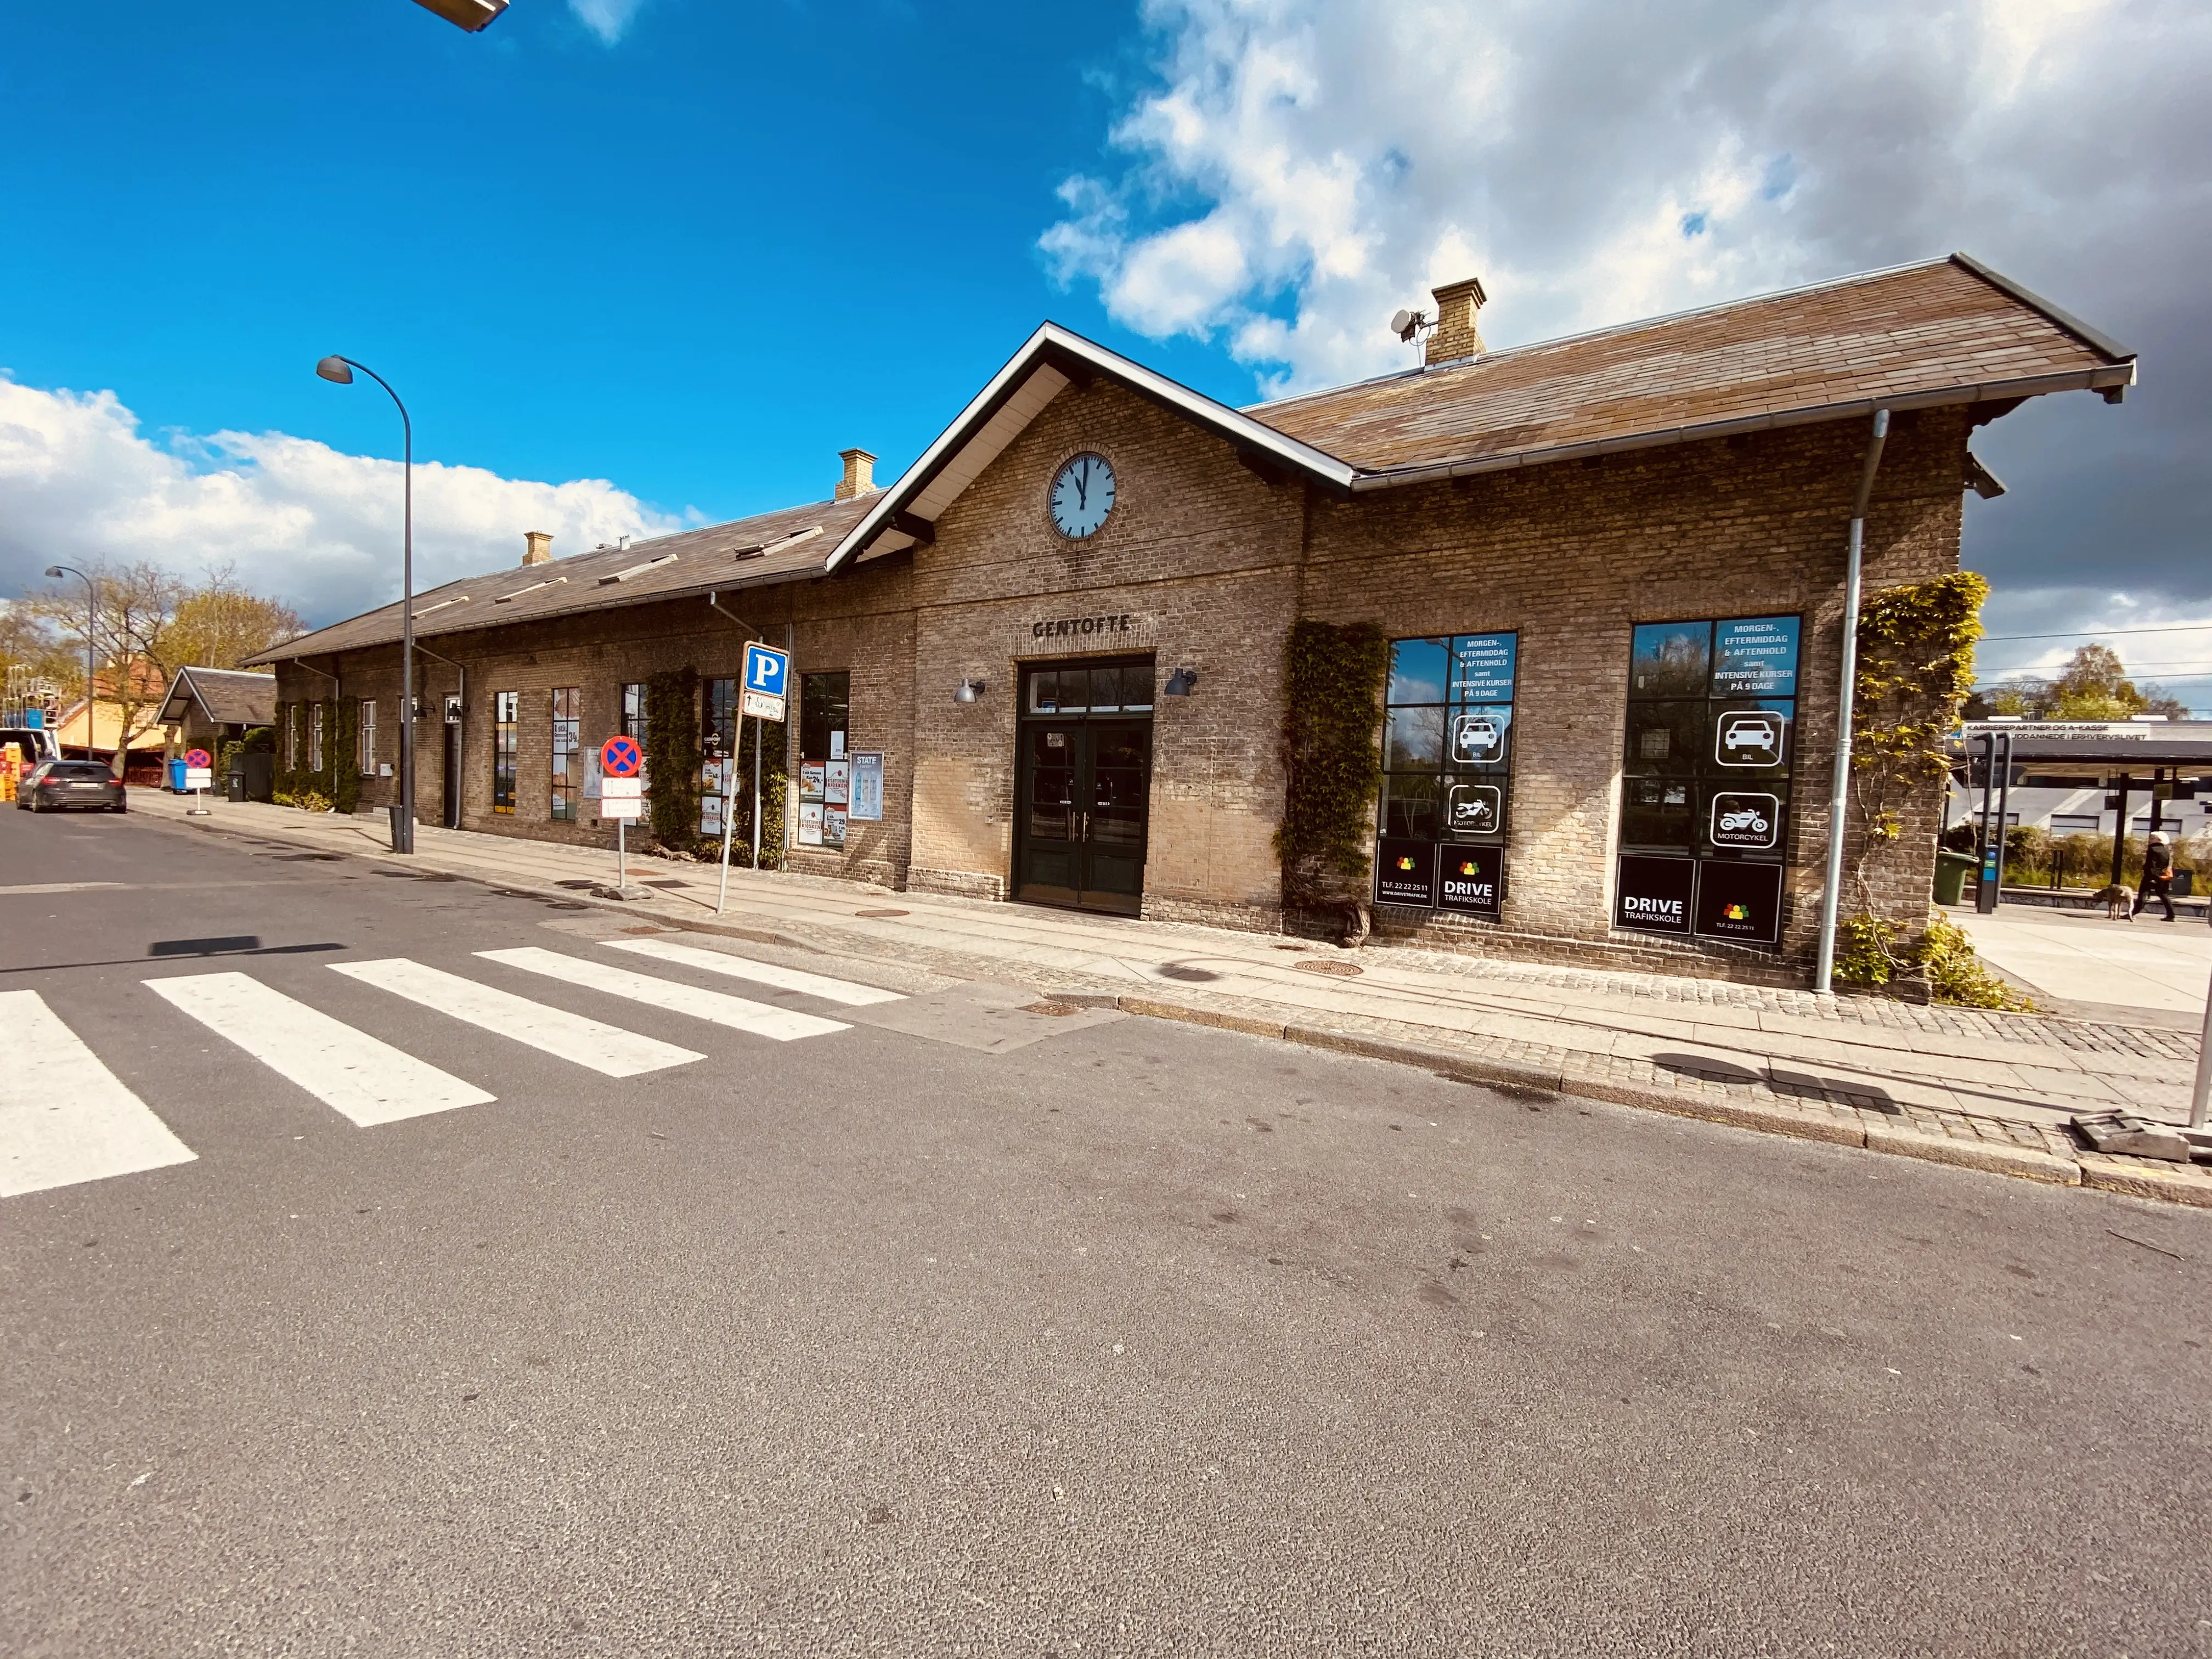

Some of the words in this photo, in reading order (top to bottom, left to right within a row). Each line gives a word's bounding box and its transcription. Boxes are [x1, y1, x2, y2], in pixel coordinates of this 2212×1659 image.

[1032, 614, 1130, 637] GENTOFTE
[1725, 635, 1788, 645] EFTERMIDDAG
[1460, 649, 1508, 658] EFTERMIDDAG
[1734, 647, 1786, 656] AFTENHOLD
[753, 653, 779, 687] P
[1714, 671, 1758, 679] INTENSIVE
[1759, 670, 1793, 678] KURSER
[1731, 682, 1743, 690] PÅ
[1752, 682, 1774, 690] DAGE
[1464, 689, 1474, 697] PÅ
[857, 756, 877, 764] STATE
[1717, 833, 1768, 842] MOTORCYKEL
[1444, 881, 1492, 897] DRIVE
[1445, 894, 1492, 905] TRAFIKSKOLE
[1624, 896, 1683, 915] DRIVE
[1624, 911, 1681, 923] TRAFIKSKOLE
